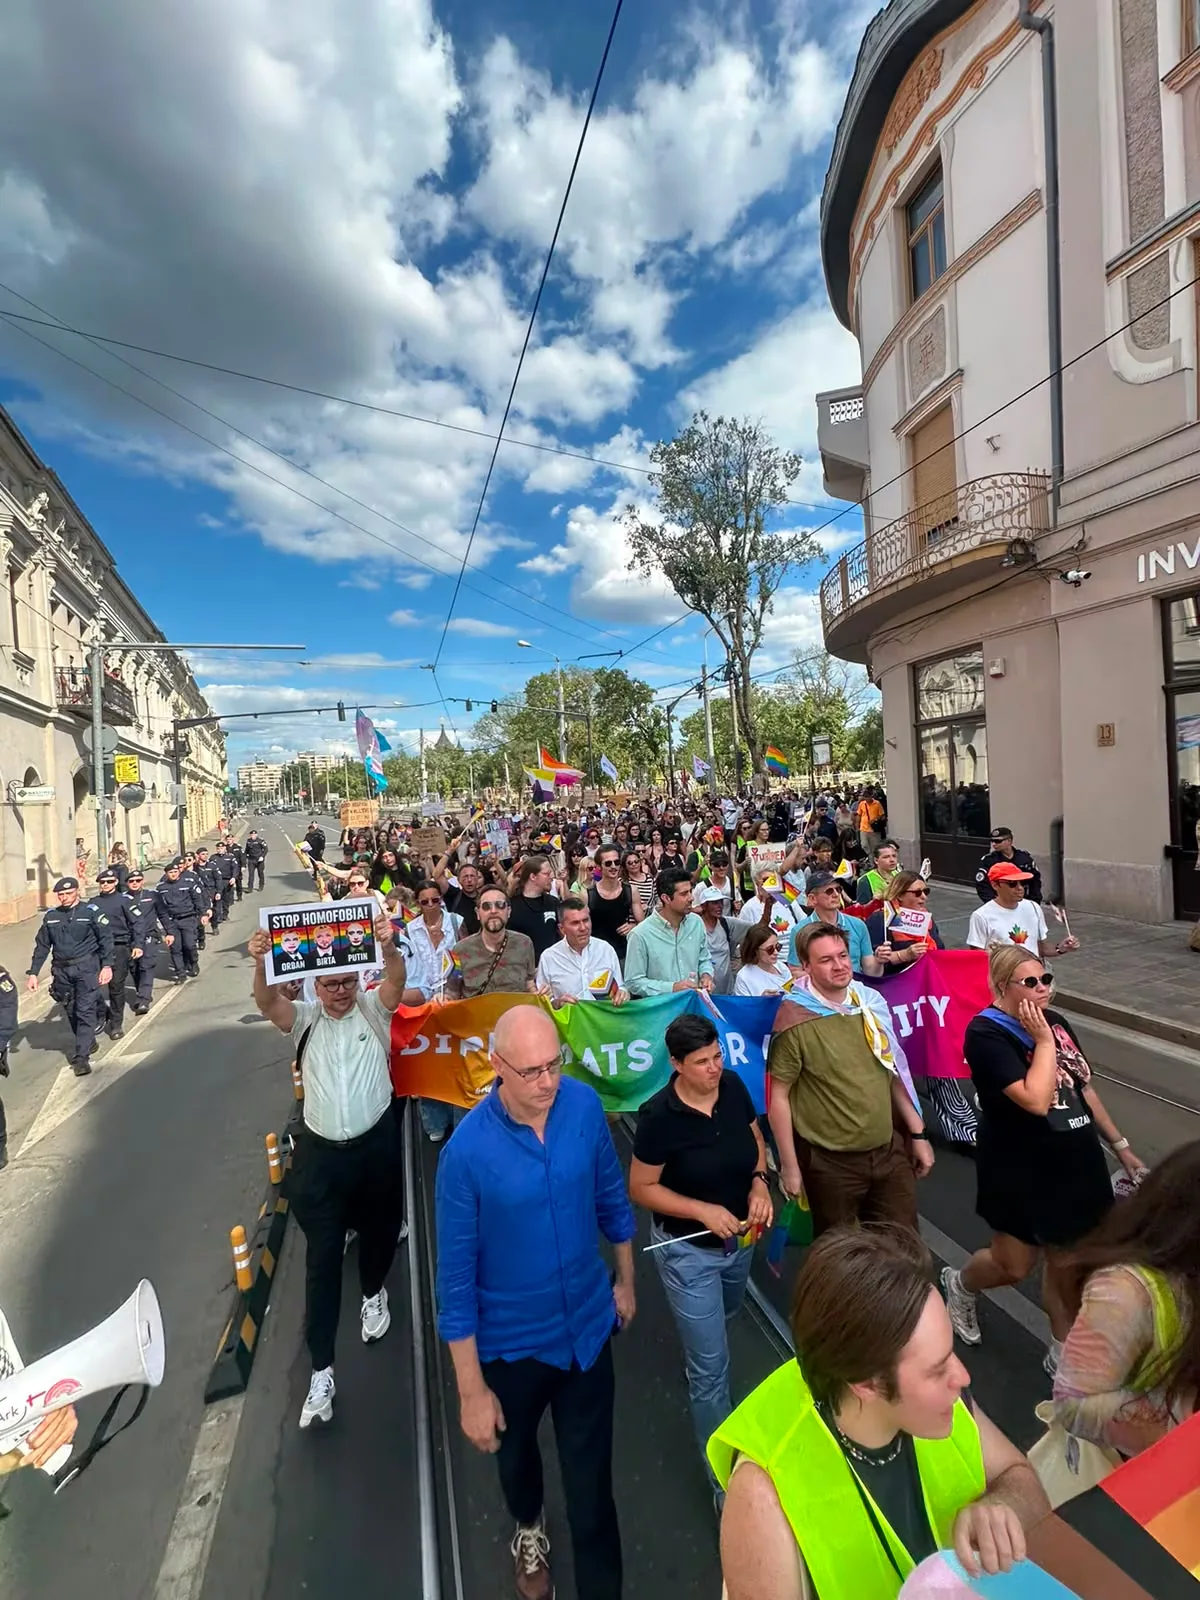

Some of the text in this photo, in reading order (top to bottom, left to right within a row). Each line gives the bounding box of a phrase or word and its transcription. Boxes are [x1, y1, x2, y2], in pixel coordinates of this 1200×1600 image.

[1100, 725, 1112, 739] 13
[272, 906, 369, 929] STOP HOMOFOBIA!
[316, 956, 336, 966] BIRTA
[347, 952, 368, 962] PUTIN
[281, 960, 305, 972] ORBAN
